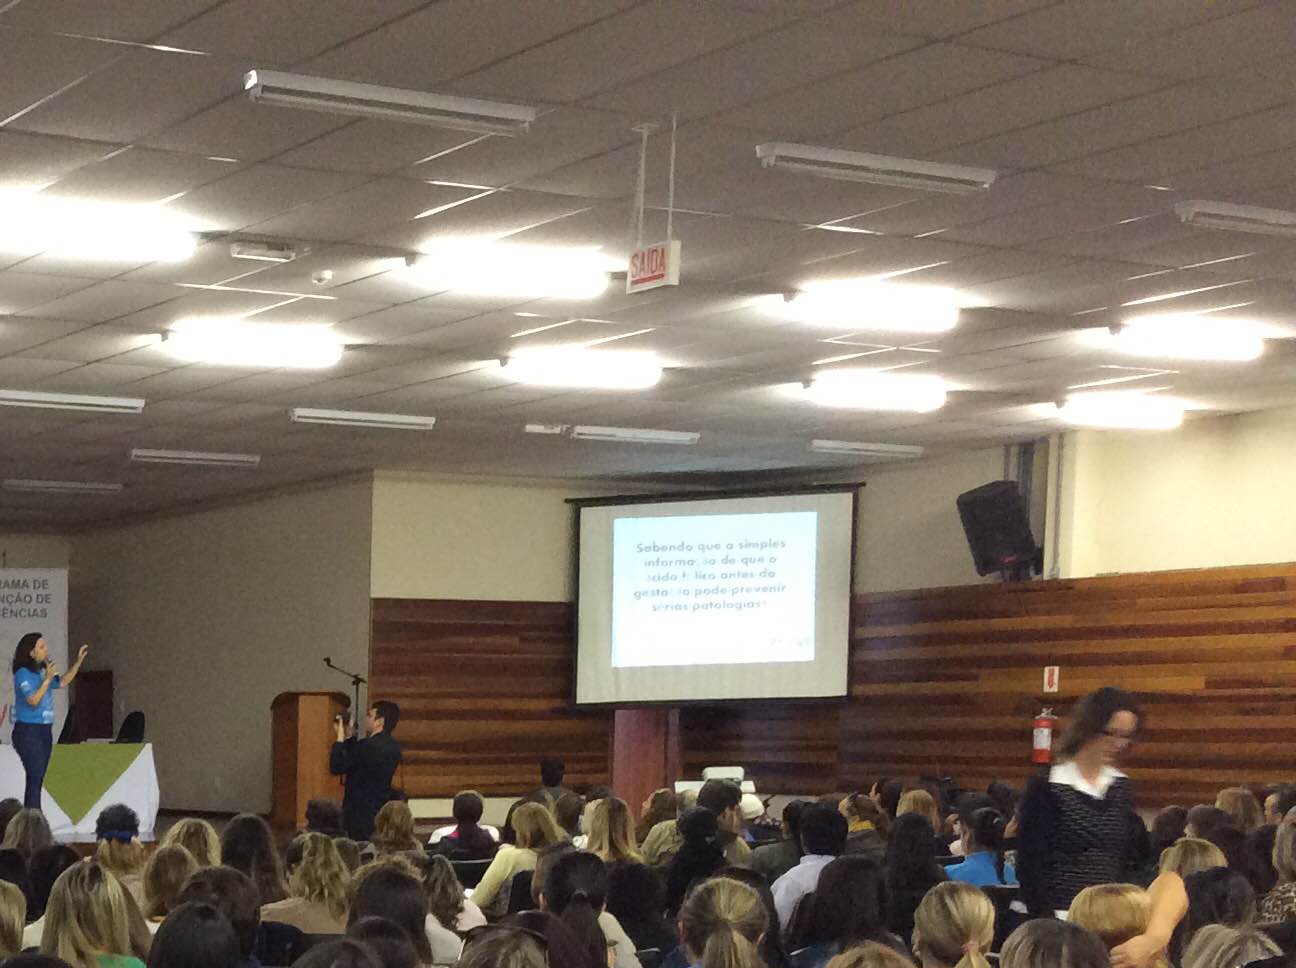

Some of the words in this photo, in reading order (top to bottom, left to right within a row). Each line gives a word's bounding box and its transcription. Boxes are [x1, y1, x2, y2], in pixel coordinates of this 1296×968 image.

[636, 540, 693, 553] Sabendo
[697, 542, 721, 553] que
[738, 537, 786, 551] simples
[644, 556, 717, 567] informao
[721, 555, 736, 565] de
[32, 578, 50, 590] DE
[34, 592, 52, 605] DE
[633, 587, 691, 601] gestao
[695, 585, 727, 598] pode
[731, 583, 786, 597] prevenir
